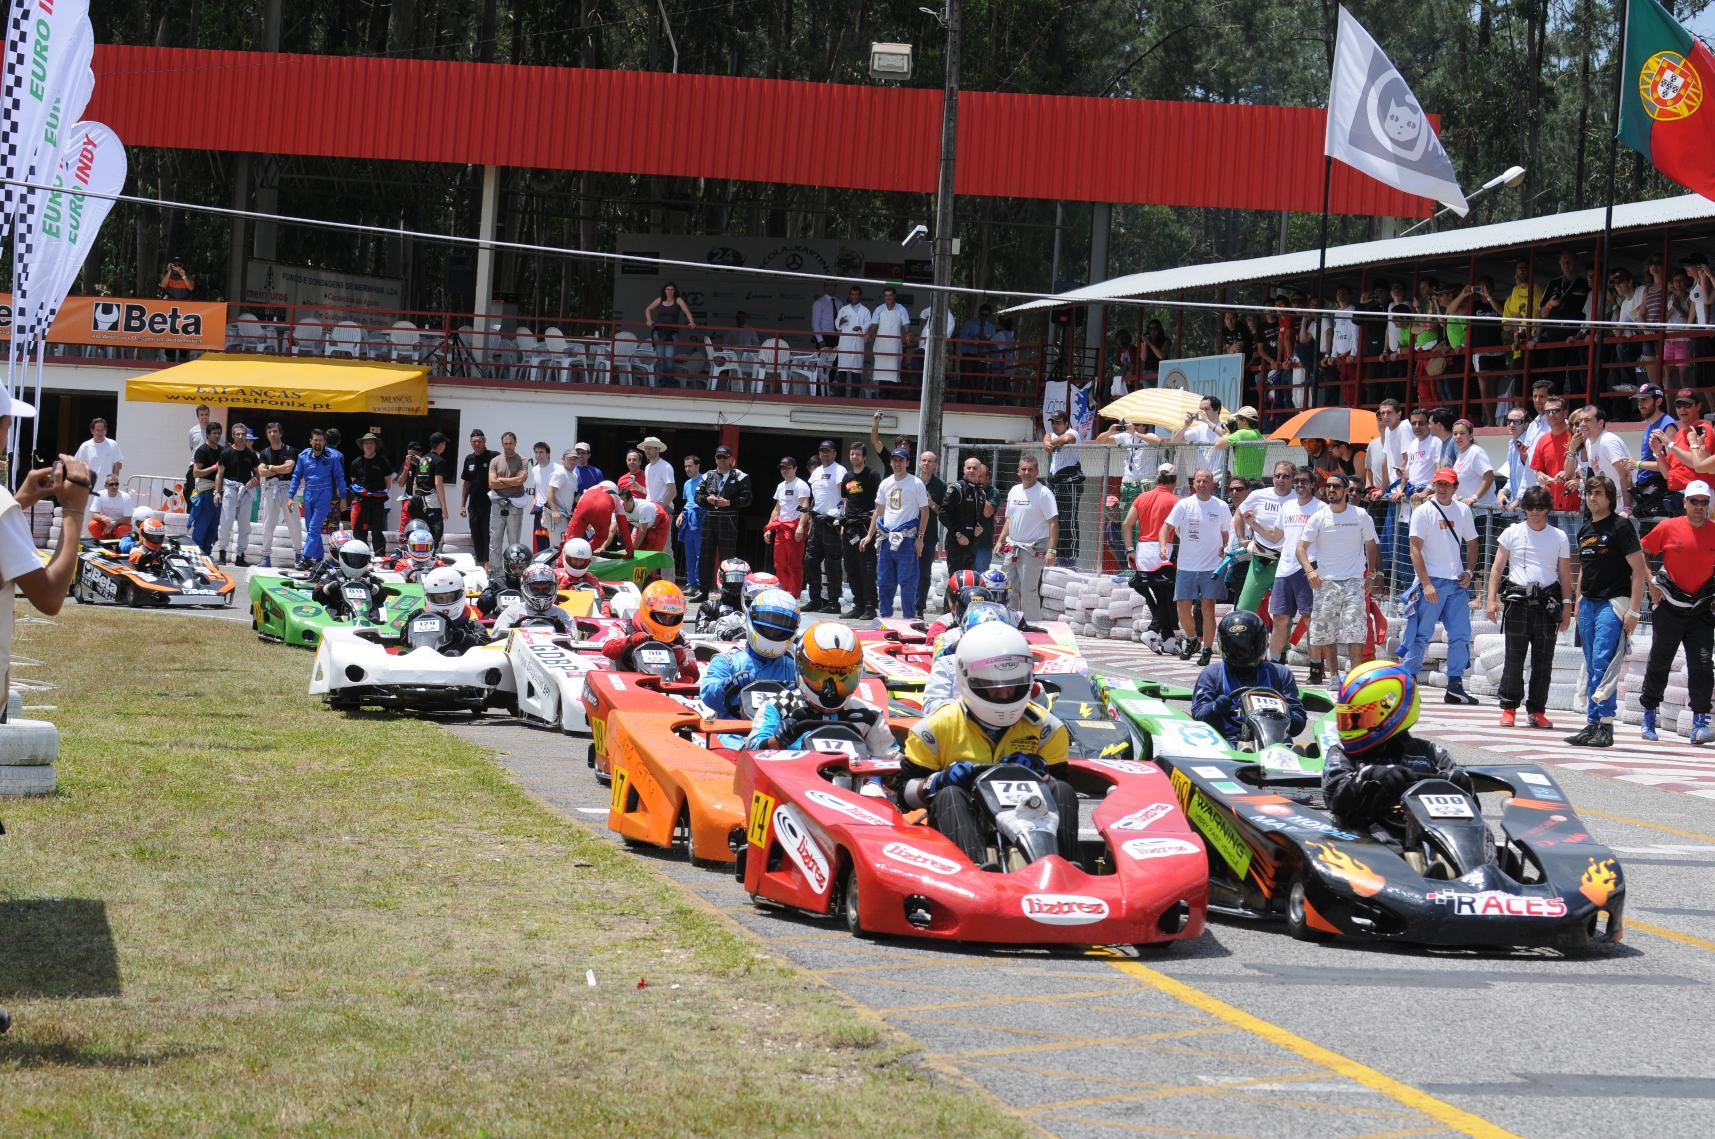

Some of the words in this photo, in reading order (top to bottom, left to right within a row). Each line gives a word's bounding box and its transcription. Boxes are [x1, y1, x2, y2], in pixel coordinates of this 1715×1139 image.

[29, 18, 51, 103] EURO
[75, 133, 97, 186] INDY
[68, 185, 86, 245] EURO
[122, 303, 204, 337] Beta
[165, 393, 333, 411] www.pestronix.pt
[92, 567, 118, 595] Beta
[820, 739, 844, 750] 17
[611, 769, 626, 807] 17
[997, 782, 1034, 794] 74
[751, 796, 768, 843] 74
[1197, 795, 1246, 858] WARNING
[1026, 899, 1106, 915] liztrez
[1457, 895, 1567, 917] RACES
